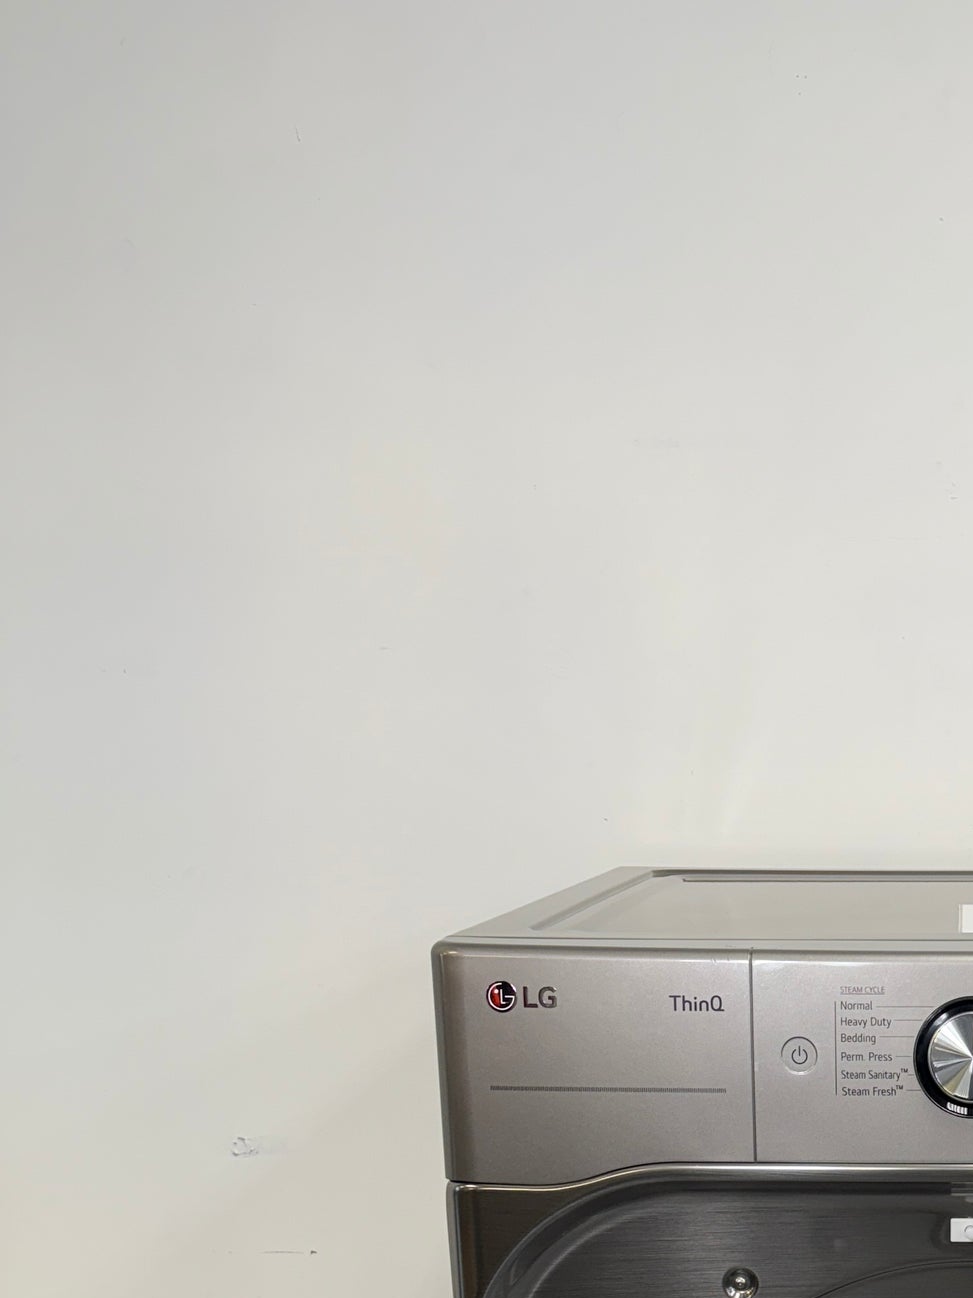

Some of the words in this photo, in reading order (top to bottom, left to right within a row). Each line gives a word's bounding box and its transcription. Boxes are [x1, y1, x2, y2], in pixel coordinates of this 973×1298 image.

[840, 986, 862, 994] STEAM
[865, 986, 886, 994] CYCLE
[523, 986, 557, 1008] LG
[669, 995, 725, 1012] ThinQ
[840, 1001, 873, 1010] Normal
[840, 1017, 867, 1028] Heavy
[870, 1016, 892, 1028] Duty
[840, 1032, 876, 1045] Bedding
[840, 1052, 865, 1061] Perm.
[868, 1051, 893, 1061] Press
[840, 1070, 867, 1080] Steam
[841, 1087, 870, 1097] Steam
